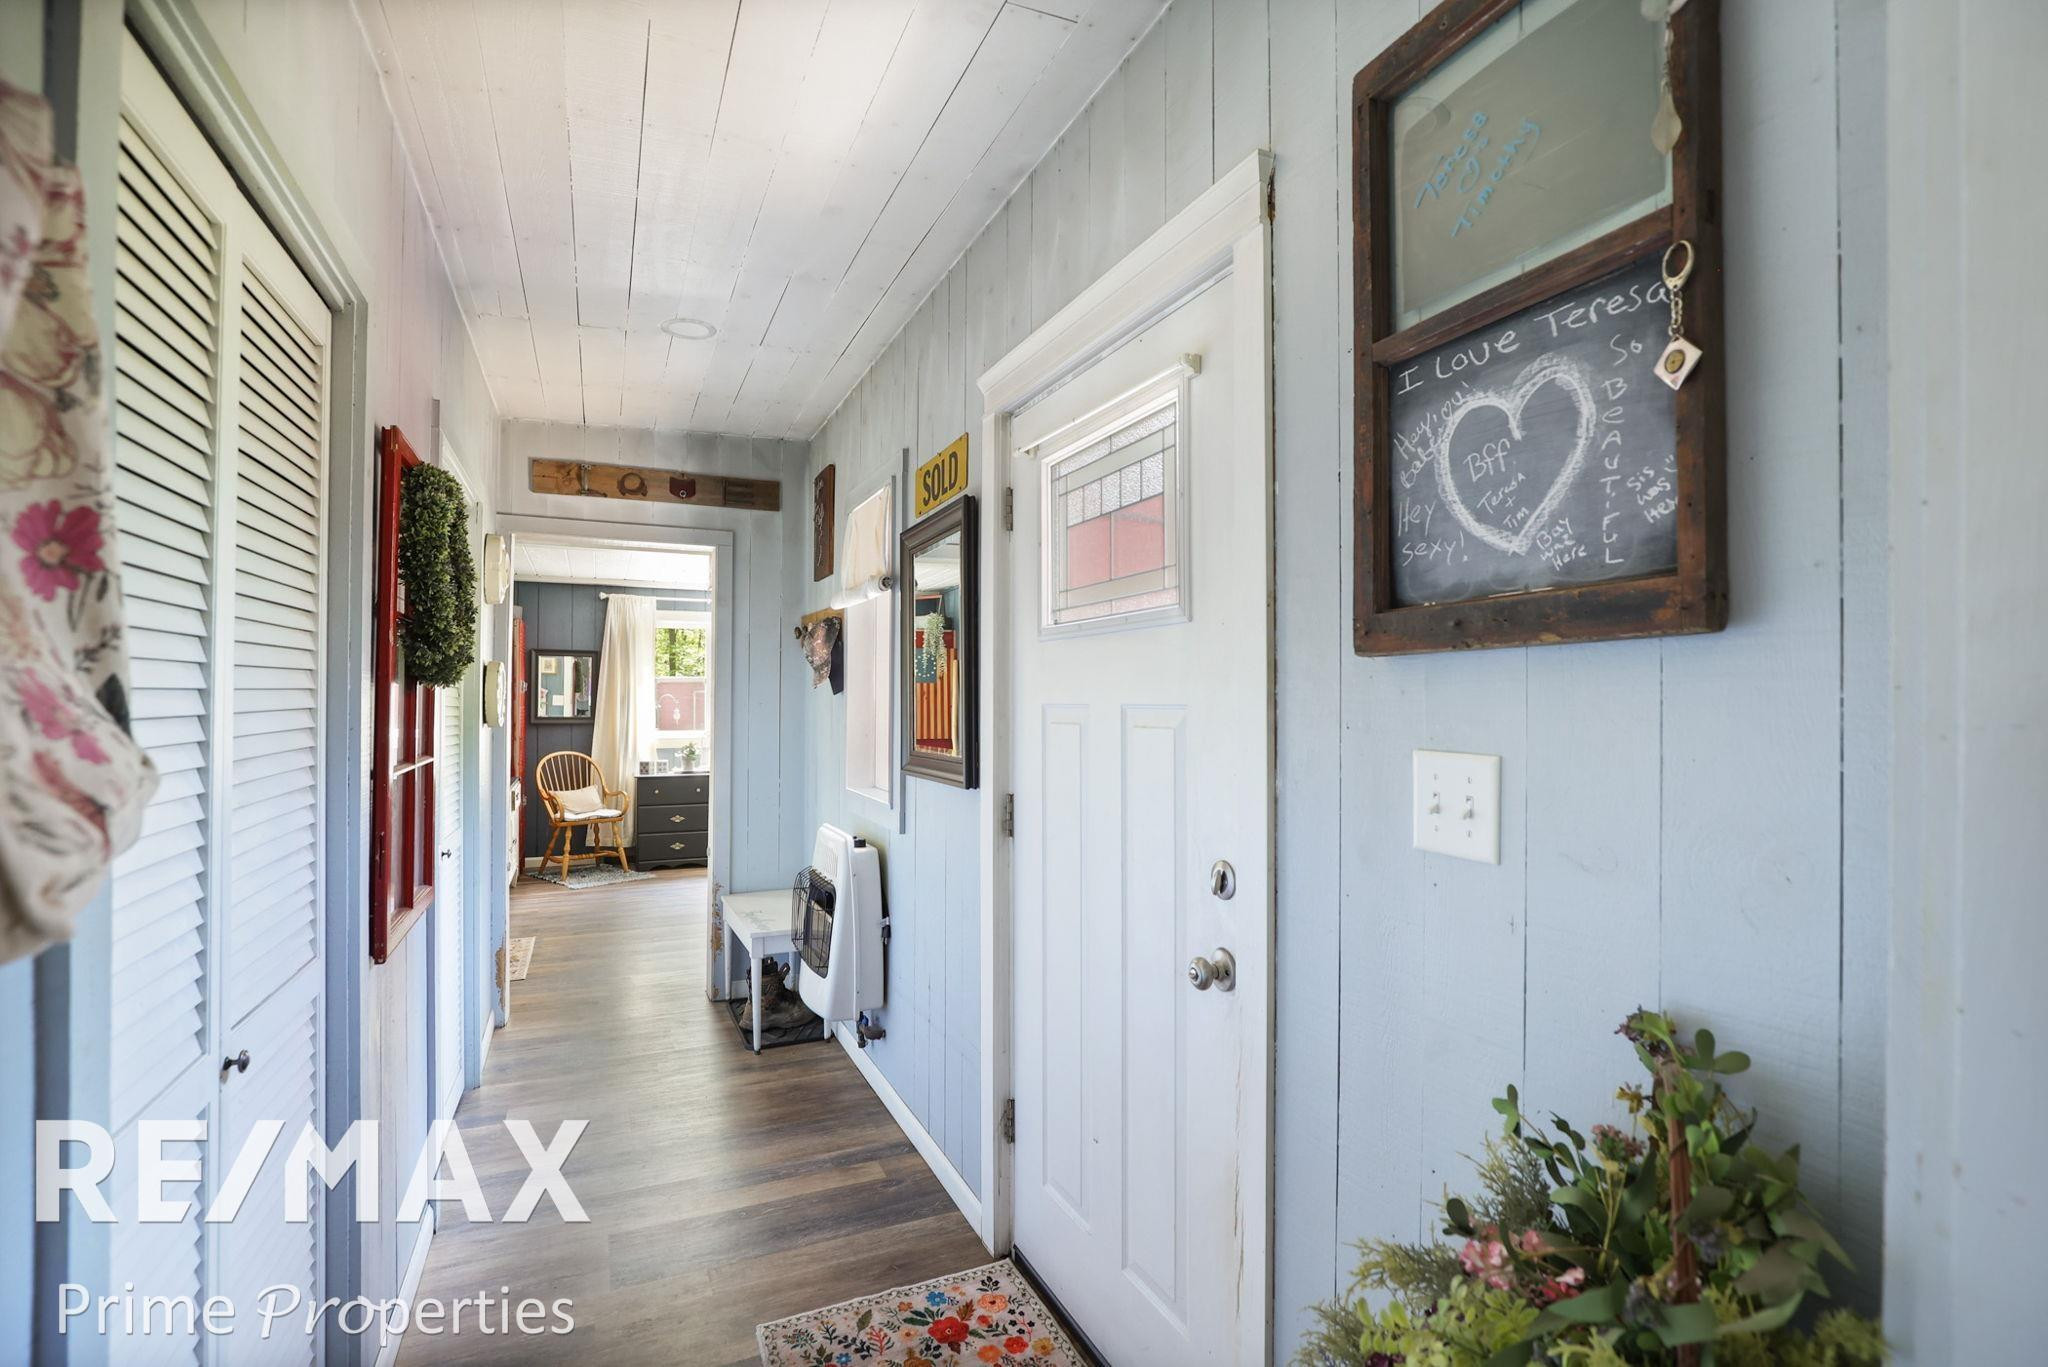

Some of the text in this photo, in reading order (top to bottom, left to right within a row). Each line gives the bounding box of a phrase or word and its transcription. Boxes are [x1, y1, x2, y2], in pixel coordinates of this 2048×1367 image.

[1397, 365, 1425, 396] I
[1533, 281, 1670, 338] Teresa
[923, 451, 959, 507] SOLD
[1398, 496, 1437, 537] Hey
